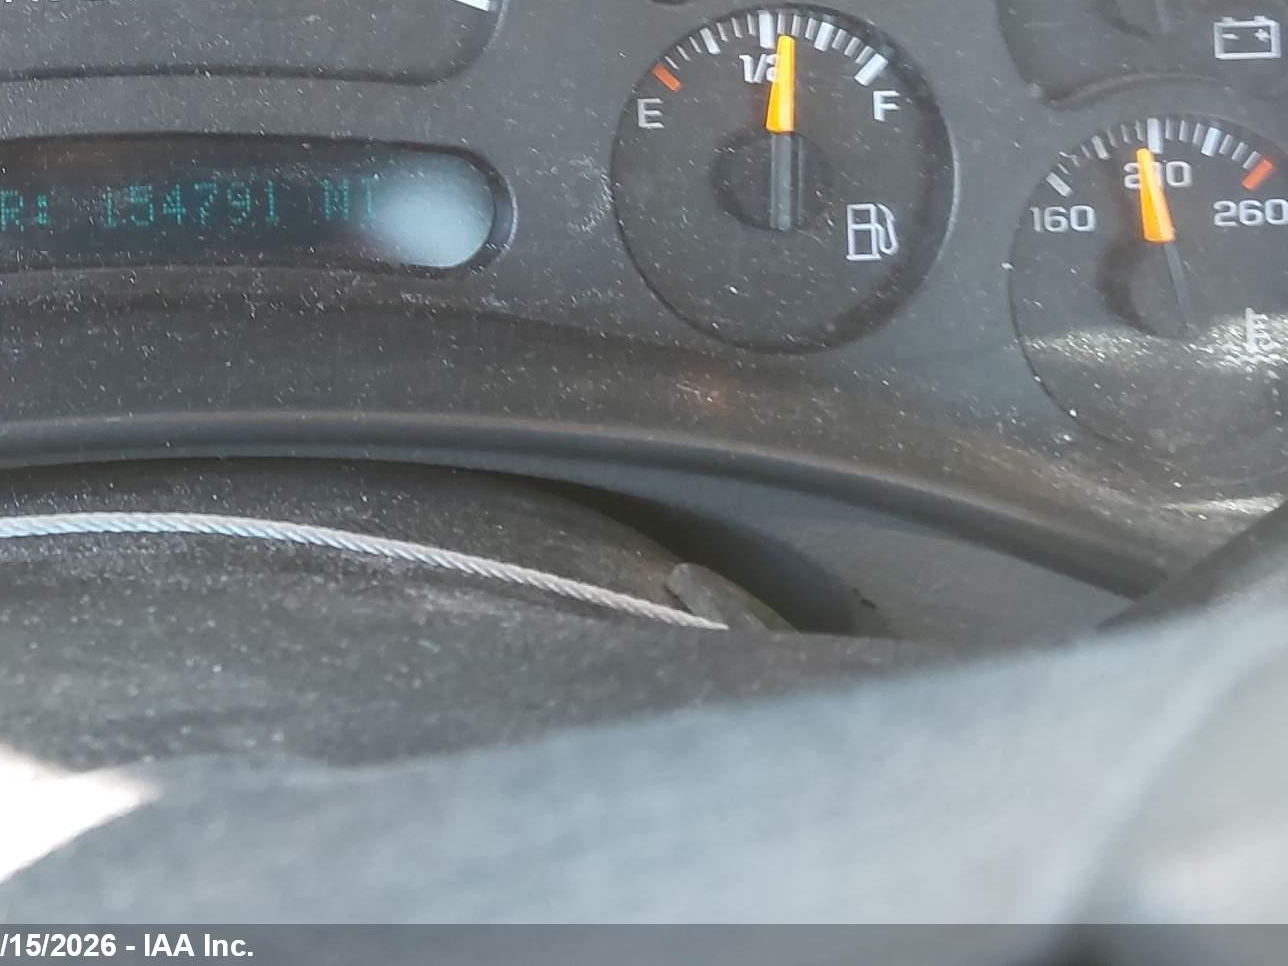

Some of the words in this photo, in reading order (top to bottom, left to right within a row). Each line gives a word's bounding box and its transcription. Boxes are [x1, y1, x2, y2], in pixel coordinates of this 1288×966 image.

[637, 97, 665, 130] E
[872, 90, 900, 122] F
[104, 180, 279, 227] 154791
[1030, 205, 1097, 232] 160
[1213, 198, 1288, 227] 260
